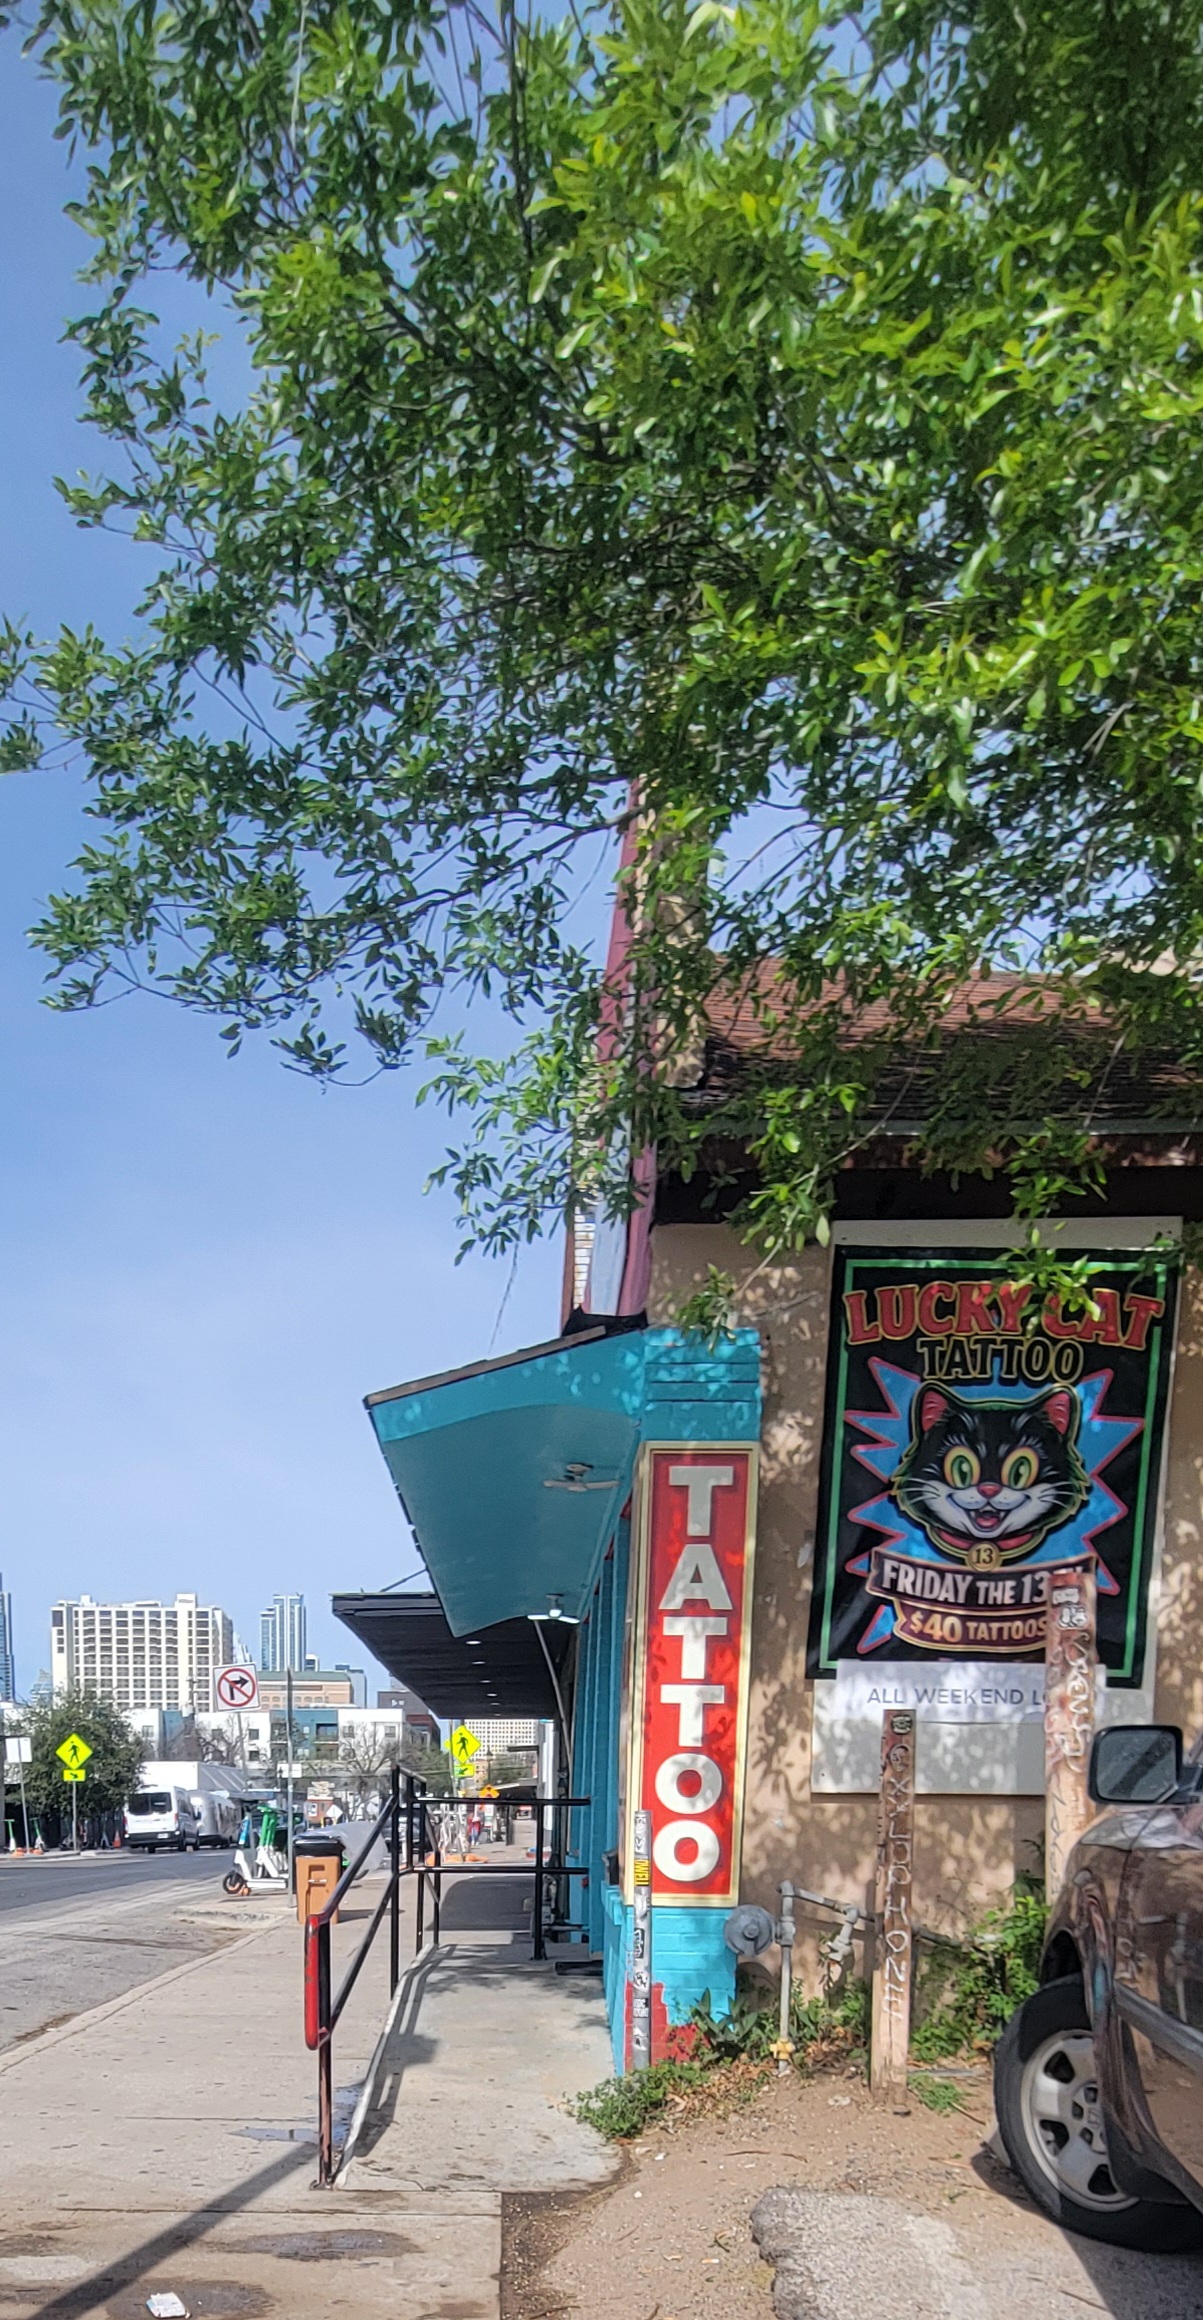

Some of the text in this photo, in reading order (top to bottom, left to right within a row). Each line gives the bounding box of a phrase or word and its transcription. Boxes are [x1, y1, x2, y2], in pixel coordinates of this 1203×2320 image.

[842, 1280, 1165, 1350] LUCKY CAT
[916, 1336, 1084, 1383] TATTOO
[973, 1547, 994, 1566] 13
[881, 1558, 975, 1605] FRIDAY
[976, 1580, 1018, 1604] THE
[1022, 1566, 1083, 1604] 13
[910, 1612, 1046, 1643] $40 TATTOOS
[652, 1465, 734, 1882] TATTOO
[867, 1688, 904, 1704] ALL
